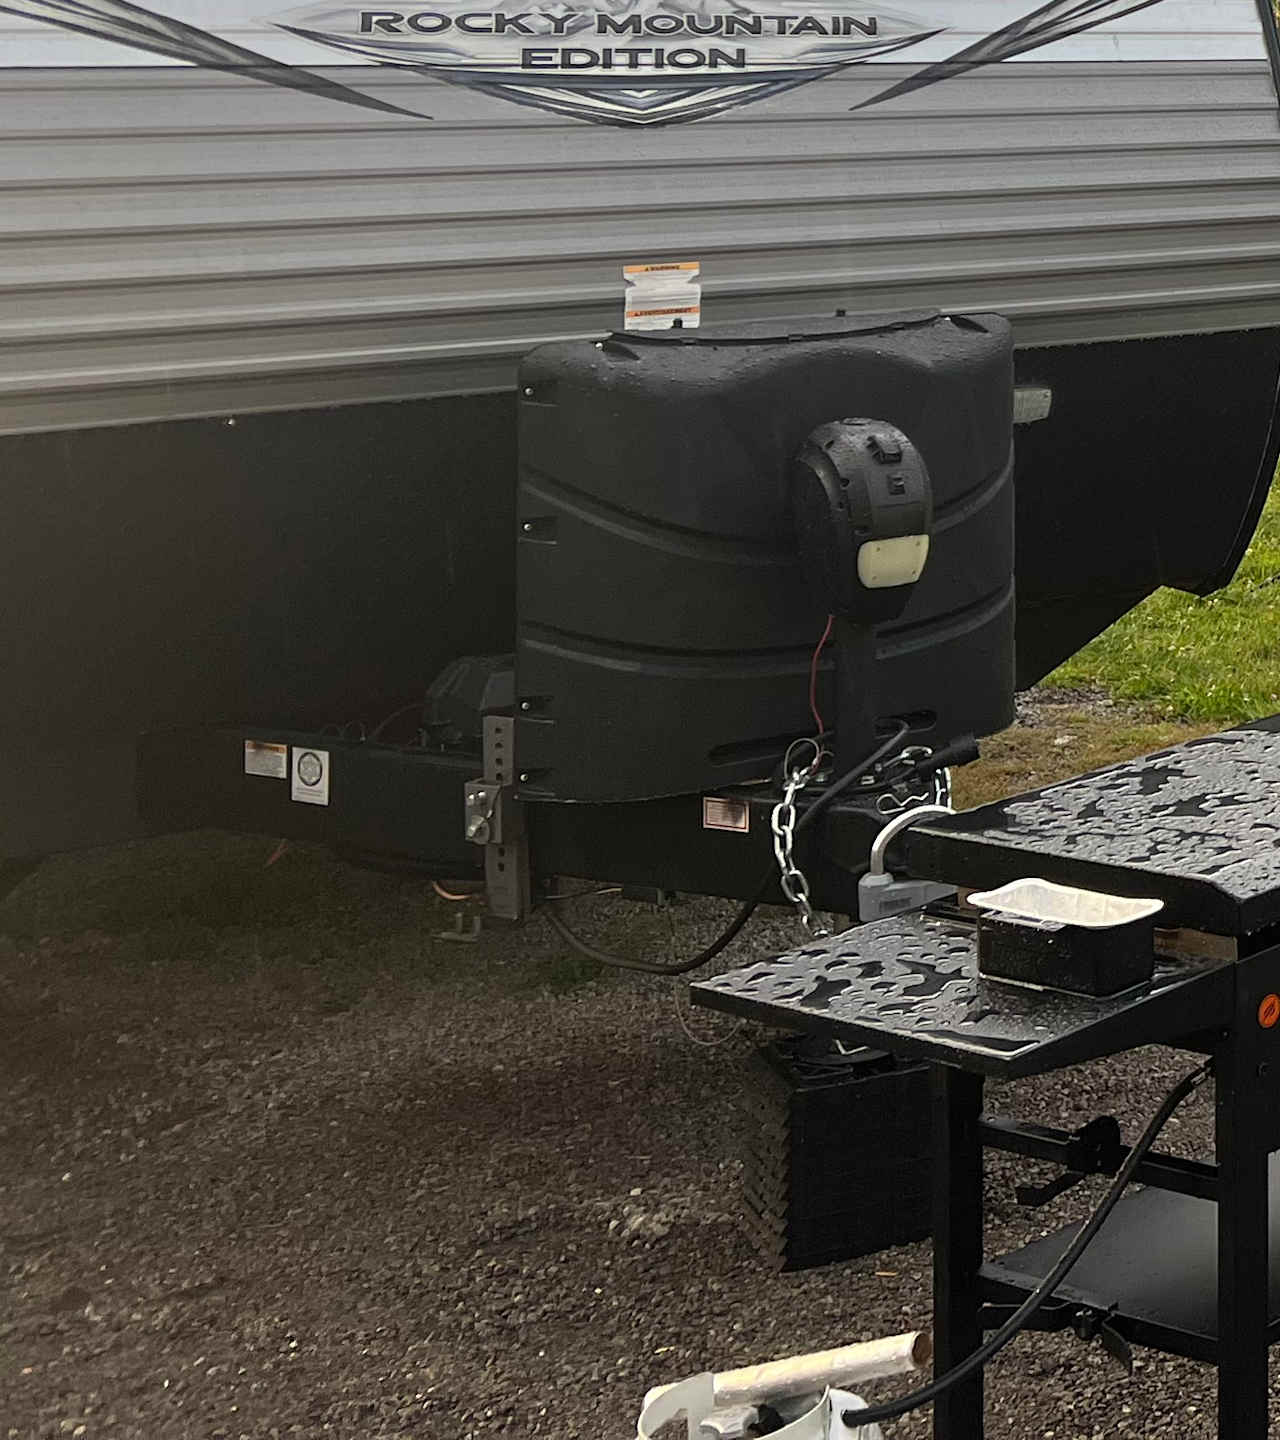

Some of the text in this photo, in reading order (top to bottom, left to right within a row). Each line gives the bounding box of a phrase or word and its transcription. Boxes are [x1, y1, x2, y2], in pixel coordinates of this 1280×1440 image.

[359, 11, 879, 37] ROCKY MOUNTAIN
[520, 47, 747, 70] EDITION
